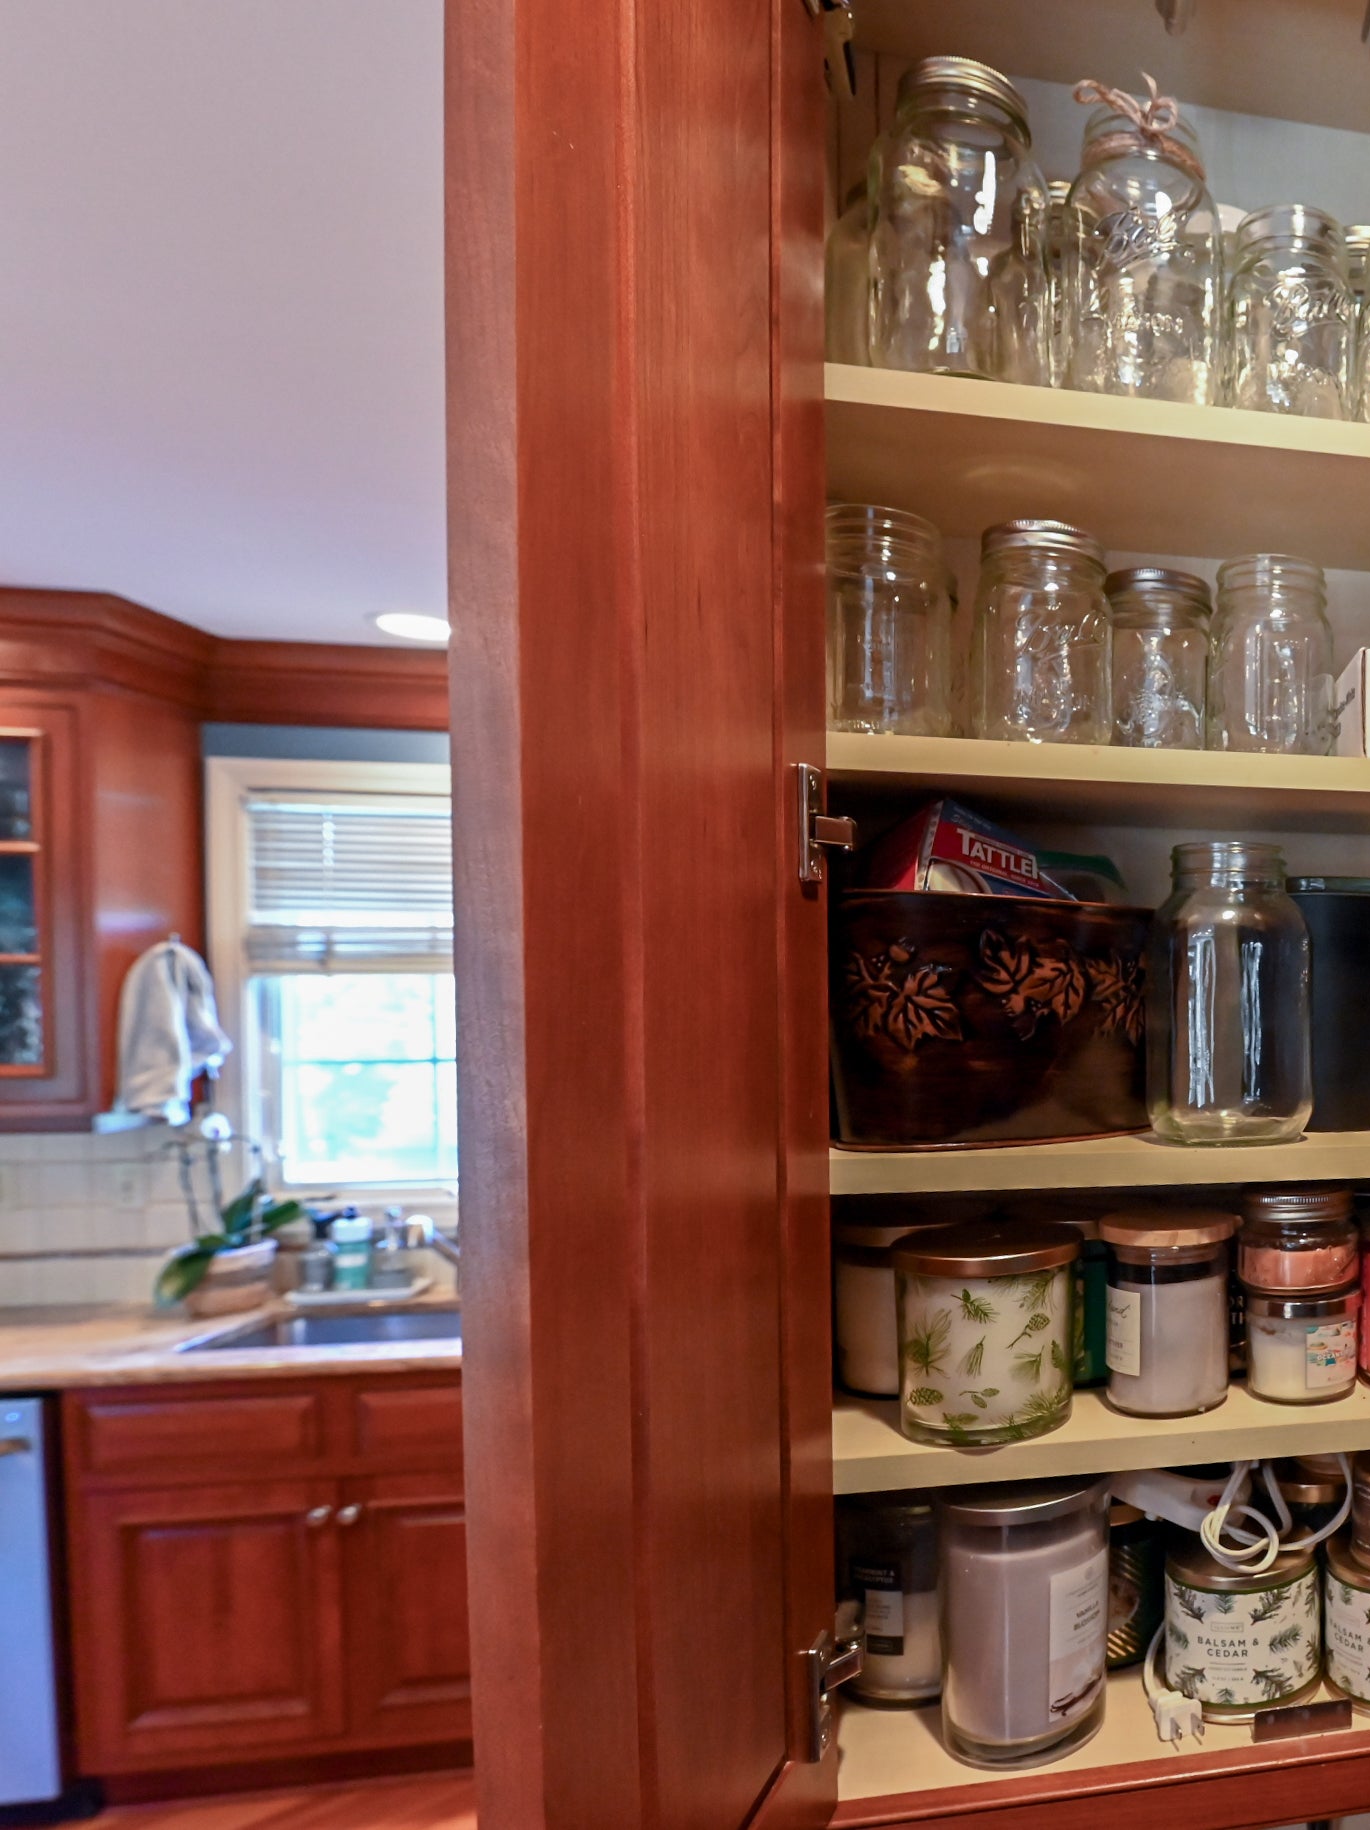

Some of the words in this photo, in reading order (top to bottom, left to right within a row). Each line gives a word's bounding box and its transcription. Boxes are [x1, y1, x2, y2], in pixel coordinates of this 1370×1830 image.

[1197, 1636, 1246, 1648] BALSAM
[1252, 1637, 1259, 1647] &
[1334, 1632, 1364, 1653] CEDAR
[1207, 1648, 1249, 1658] CEDAR
